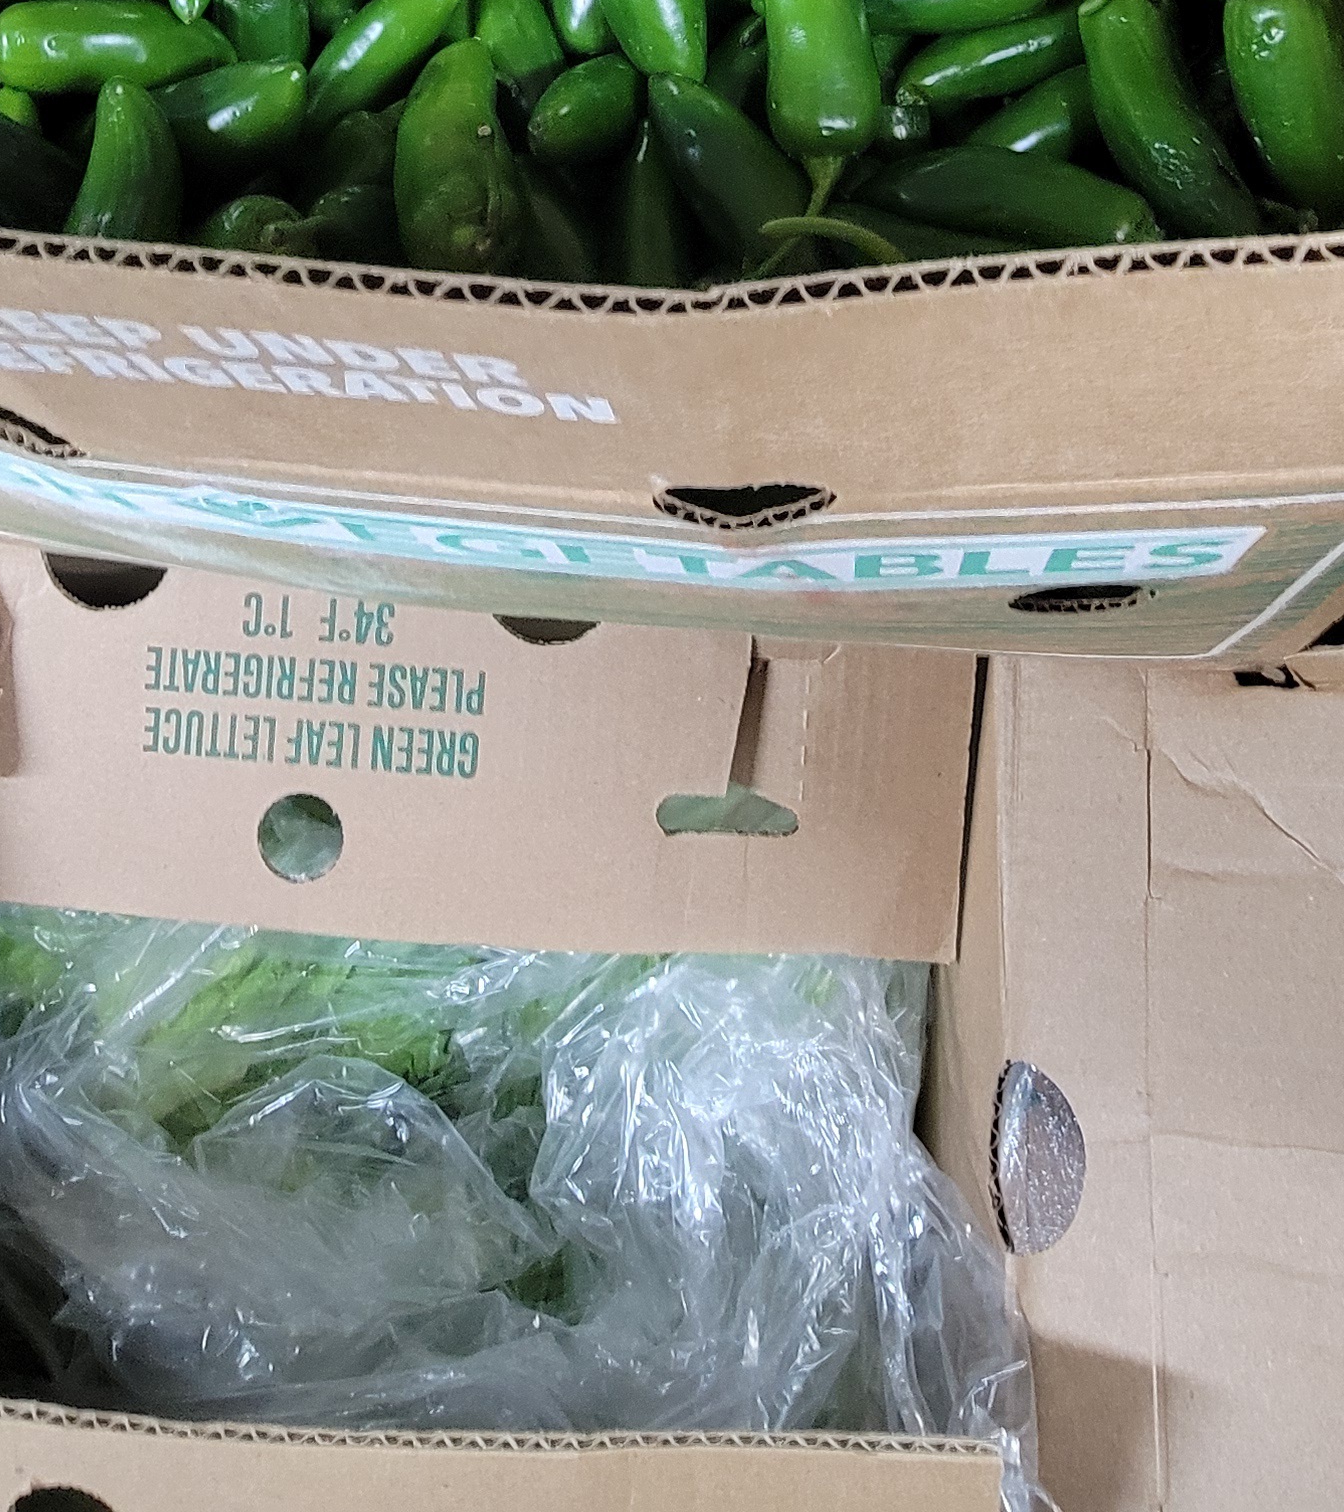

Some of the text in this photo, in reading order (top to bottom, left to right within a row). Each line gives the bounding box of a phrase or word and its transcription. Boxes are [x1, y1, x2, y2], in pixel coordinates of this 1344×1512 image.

[179, 324, 529, 388] UNDER
[143, 644, 487, 716] PLEASE REFRIGERATE
[142, 705, 481, 779] GREEN LEAF LETTUCE
